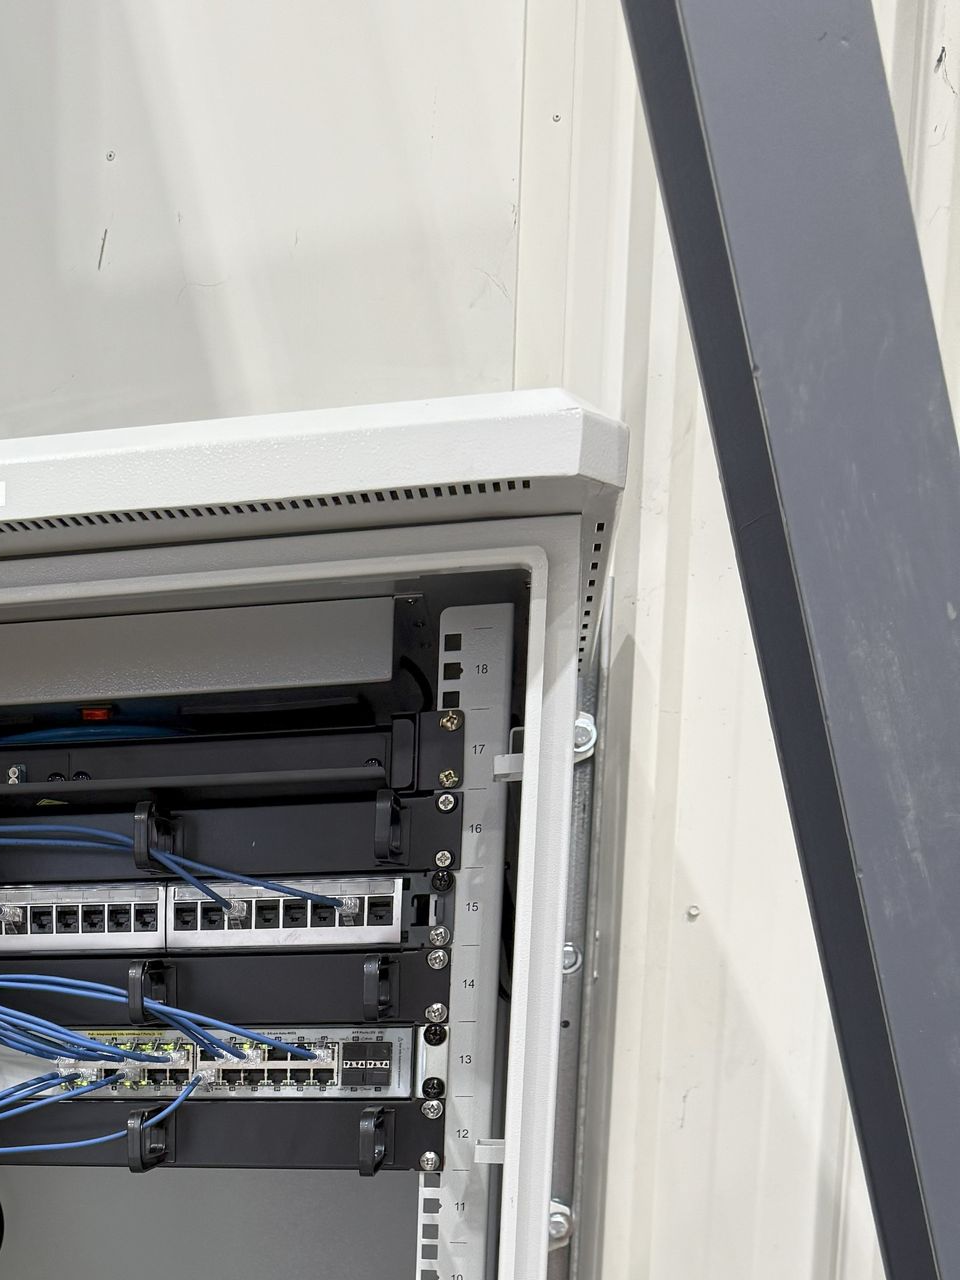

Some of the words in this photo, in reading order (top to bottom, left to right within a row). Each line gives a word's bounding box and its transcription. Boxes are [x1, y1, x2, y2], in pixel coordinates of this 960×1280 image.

[475, 664, 489, 675] 18
[472, 744, 486, 755] 17
[469, 824, 482, 834] 16
[466, 902, 479, 912] 15
[463, 979, 475, 989] 14
[459, 1055, 472, 1065] 13
[456, 1129, 469, 1139] 12
[455, 1202, 466, 1212] 11
